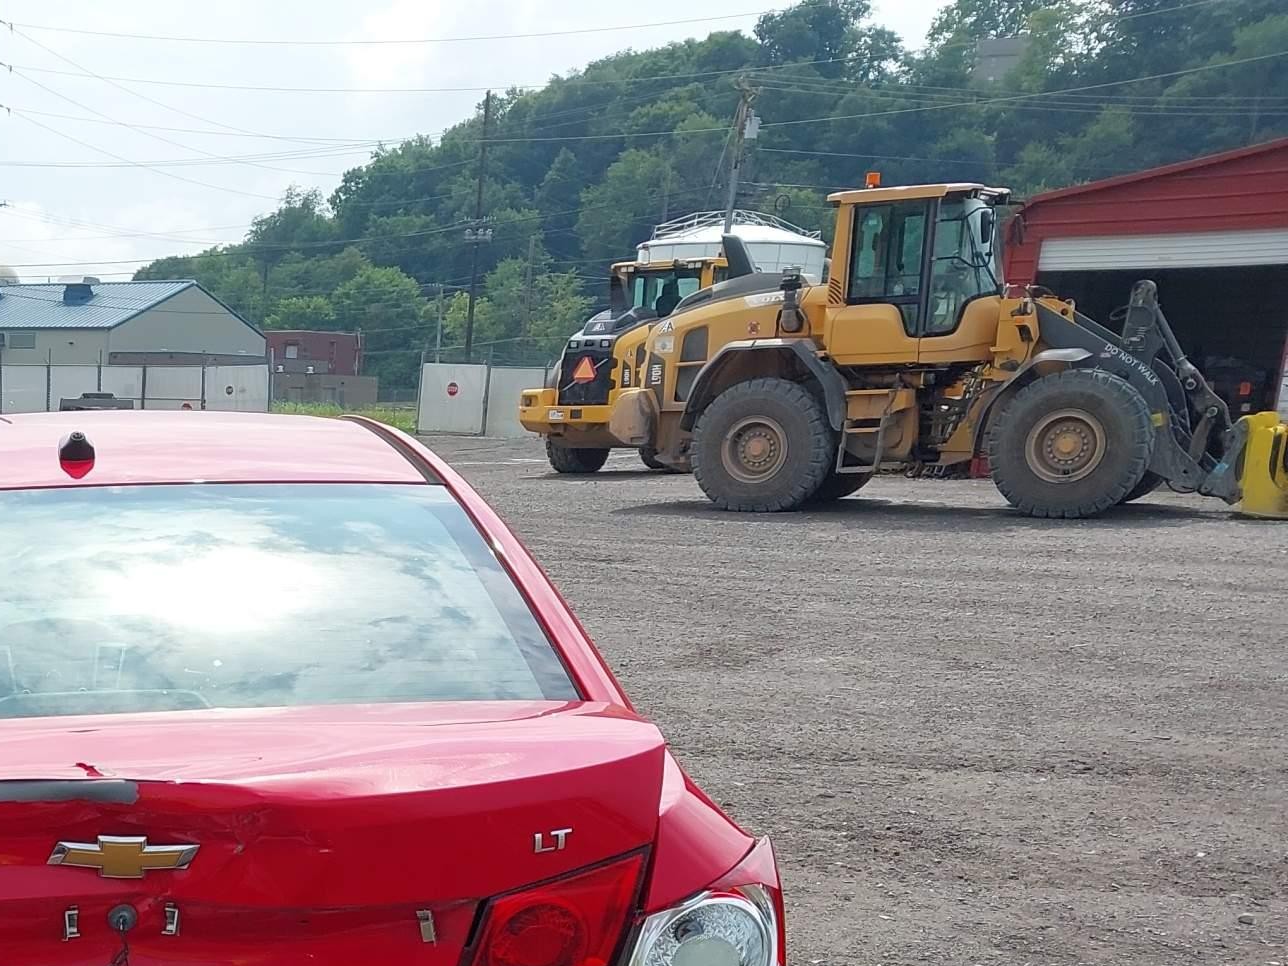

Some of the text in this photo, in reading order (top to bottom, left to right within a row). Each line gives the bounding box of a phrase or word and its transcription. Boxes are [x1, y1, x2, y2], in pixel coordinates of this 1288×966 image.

[651, 364, 662, 385] L90H
[1104, 343, 1159, 386] DO NOT WALK
[534, 828, 573, 854] LT
